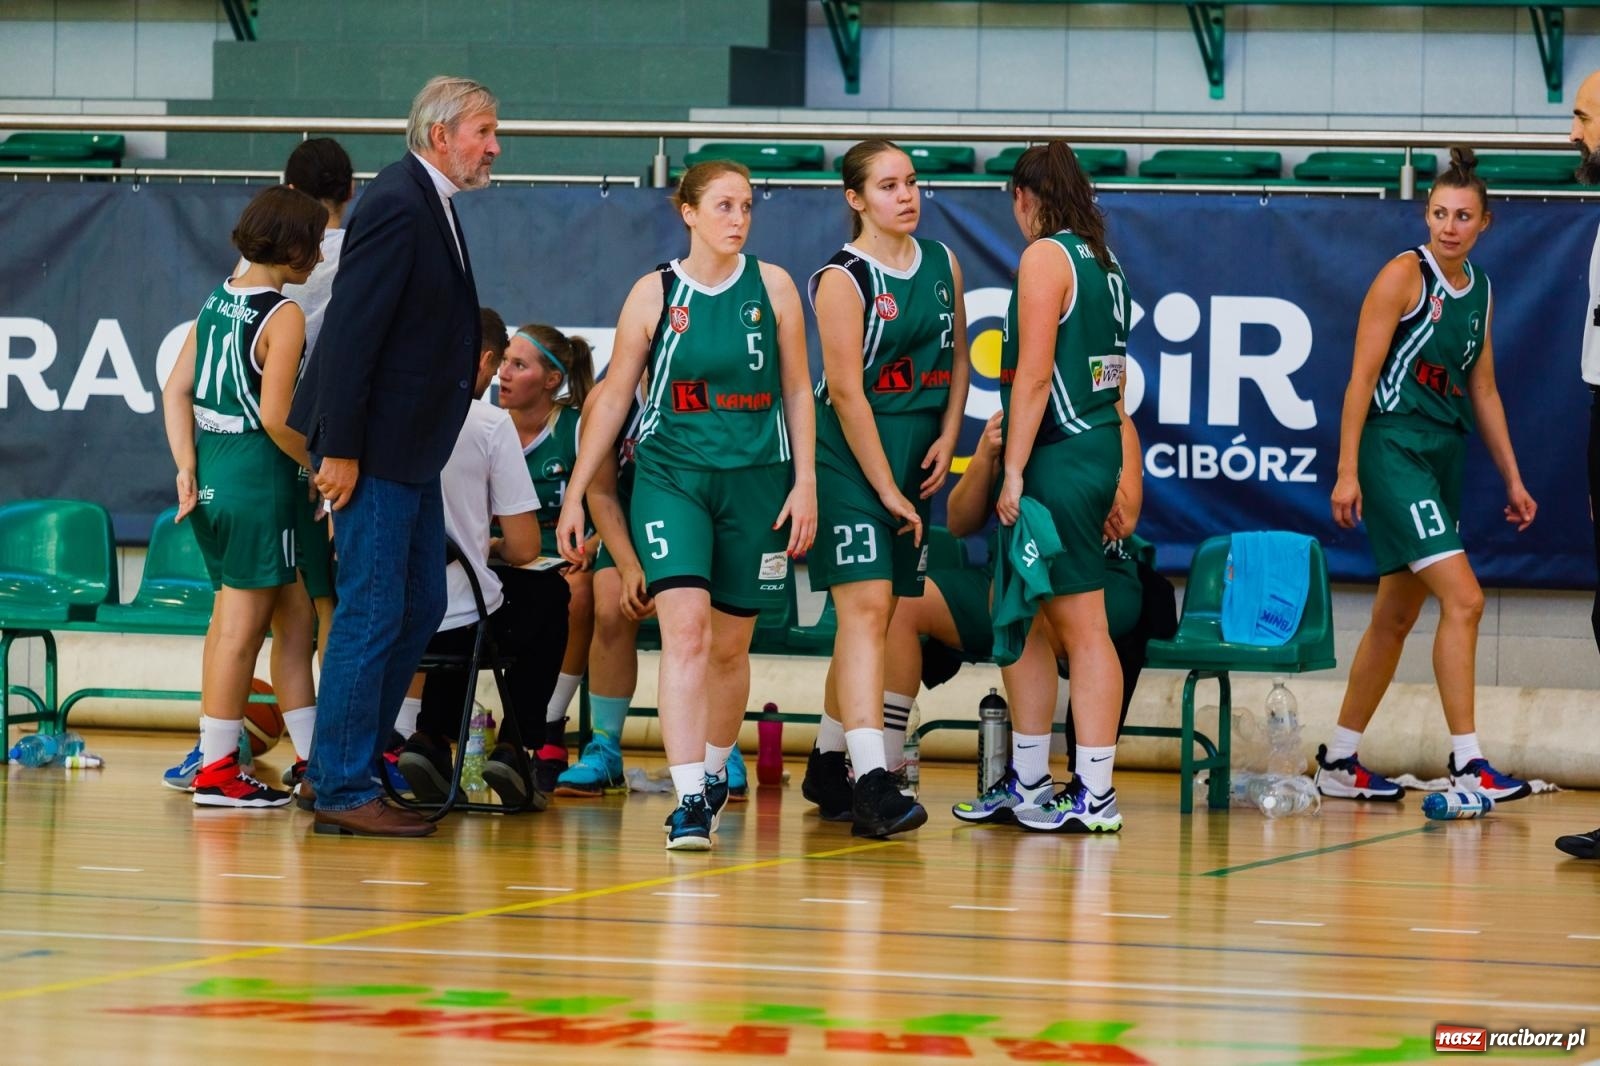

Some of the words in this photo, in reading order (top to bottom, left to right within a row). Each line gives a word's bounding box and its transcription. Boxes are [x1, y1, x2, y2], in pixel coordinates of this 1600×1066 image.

[746, 333, 764, 371] 5
[674, 384, 706, 410] K
[716, 393, 773, 410] KAMAN
[1142, 433, 1317, 482] CIBÓRZ
[1410, 499, 1446, 540] 13
[645, 520, 668, 560] 5
[833, 523, 877, 565] 23
